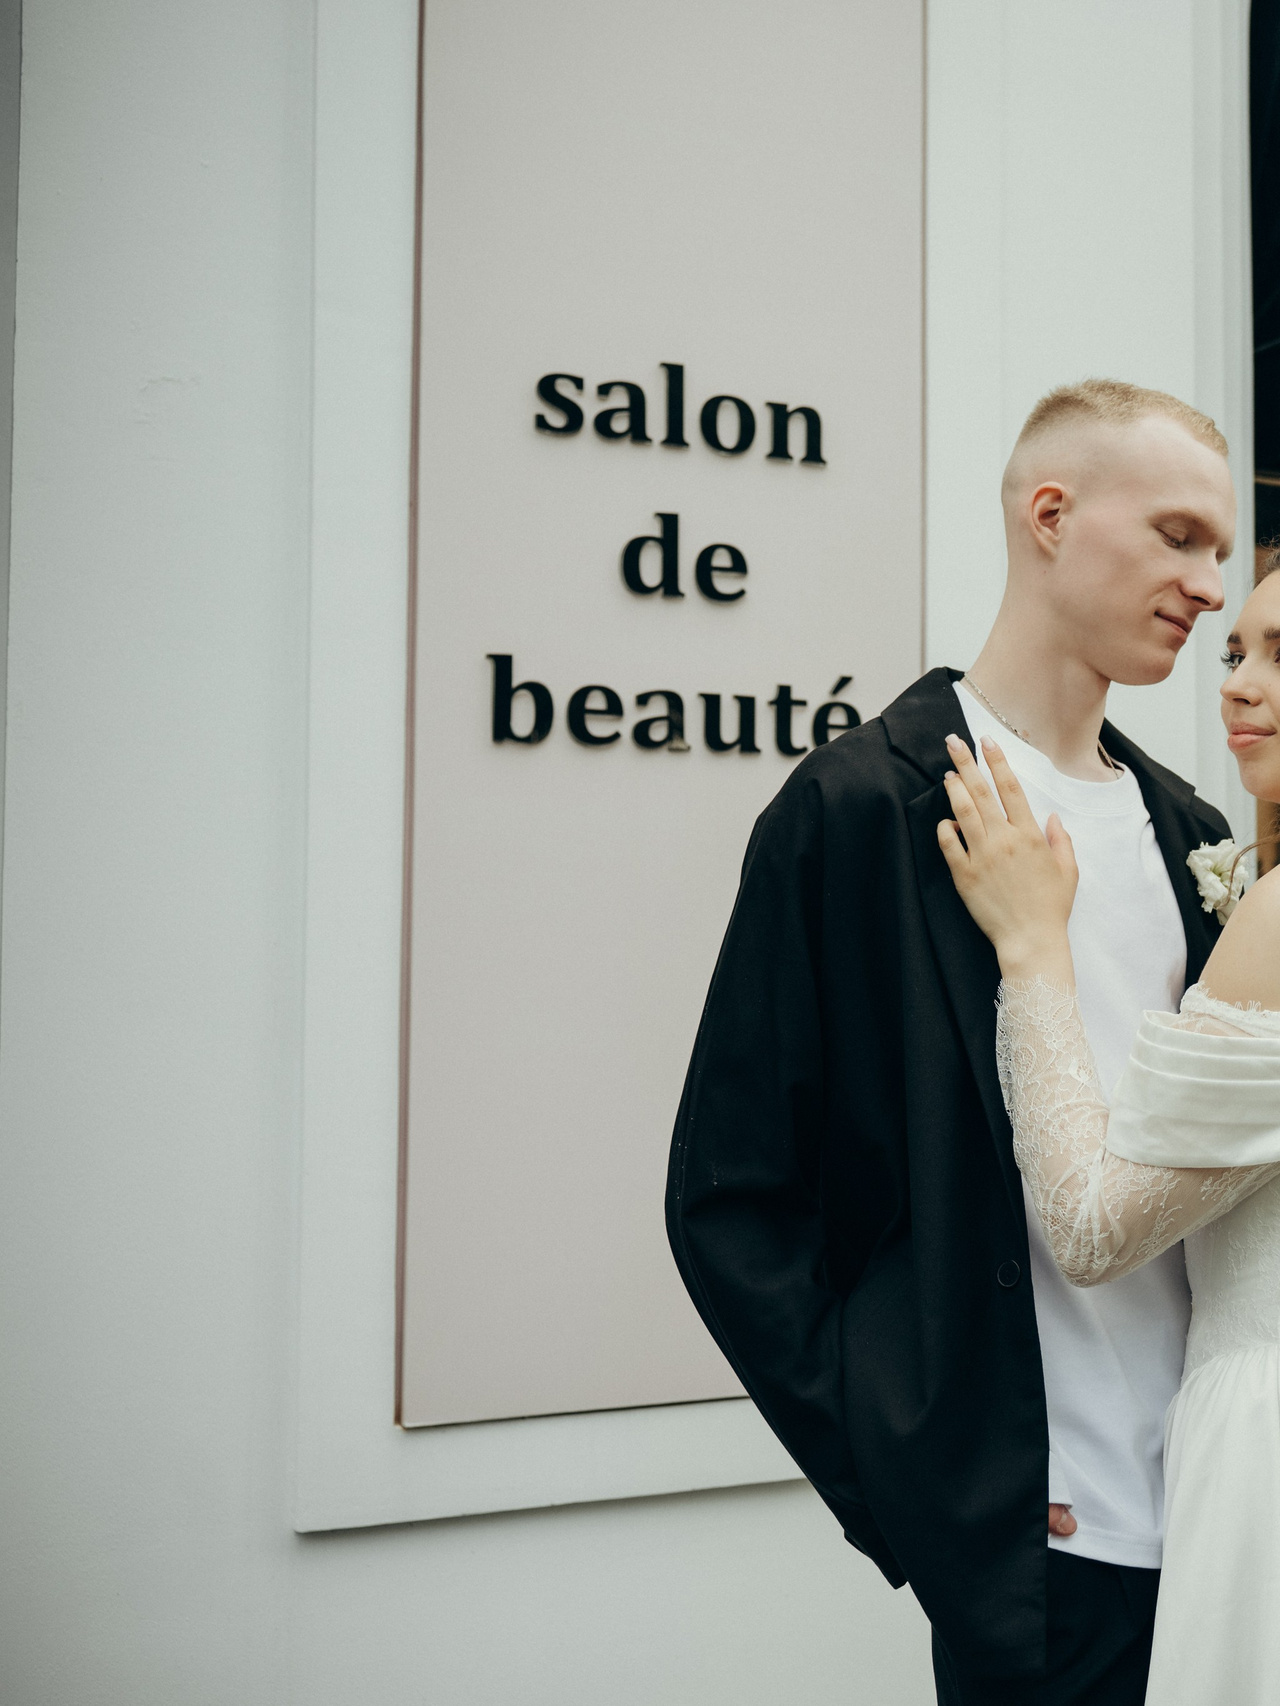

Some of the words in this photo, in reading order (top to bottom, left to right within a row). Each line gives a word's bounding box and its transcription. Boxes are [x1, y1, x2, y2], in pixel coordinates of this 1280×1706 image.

[534, 362, 827, 465] salon
[620, 512, 749, 602] de
[486, 653, 863, 757] beauté
